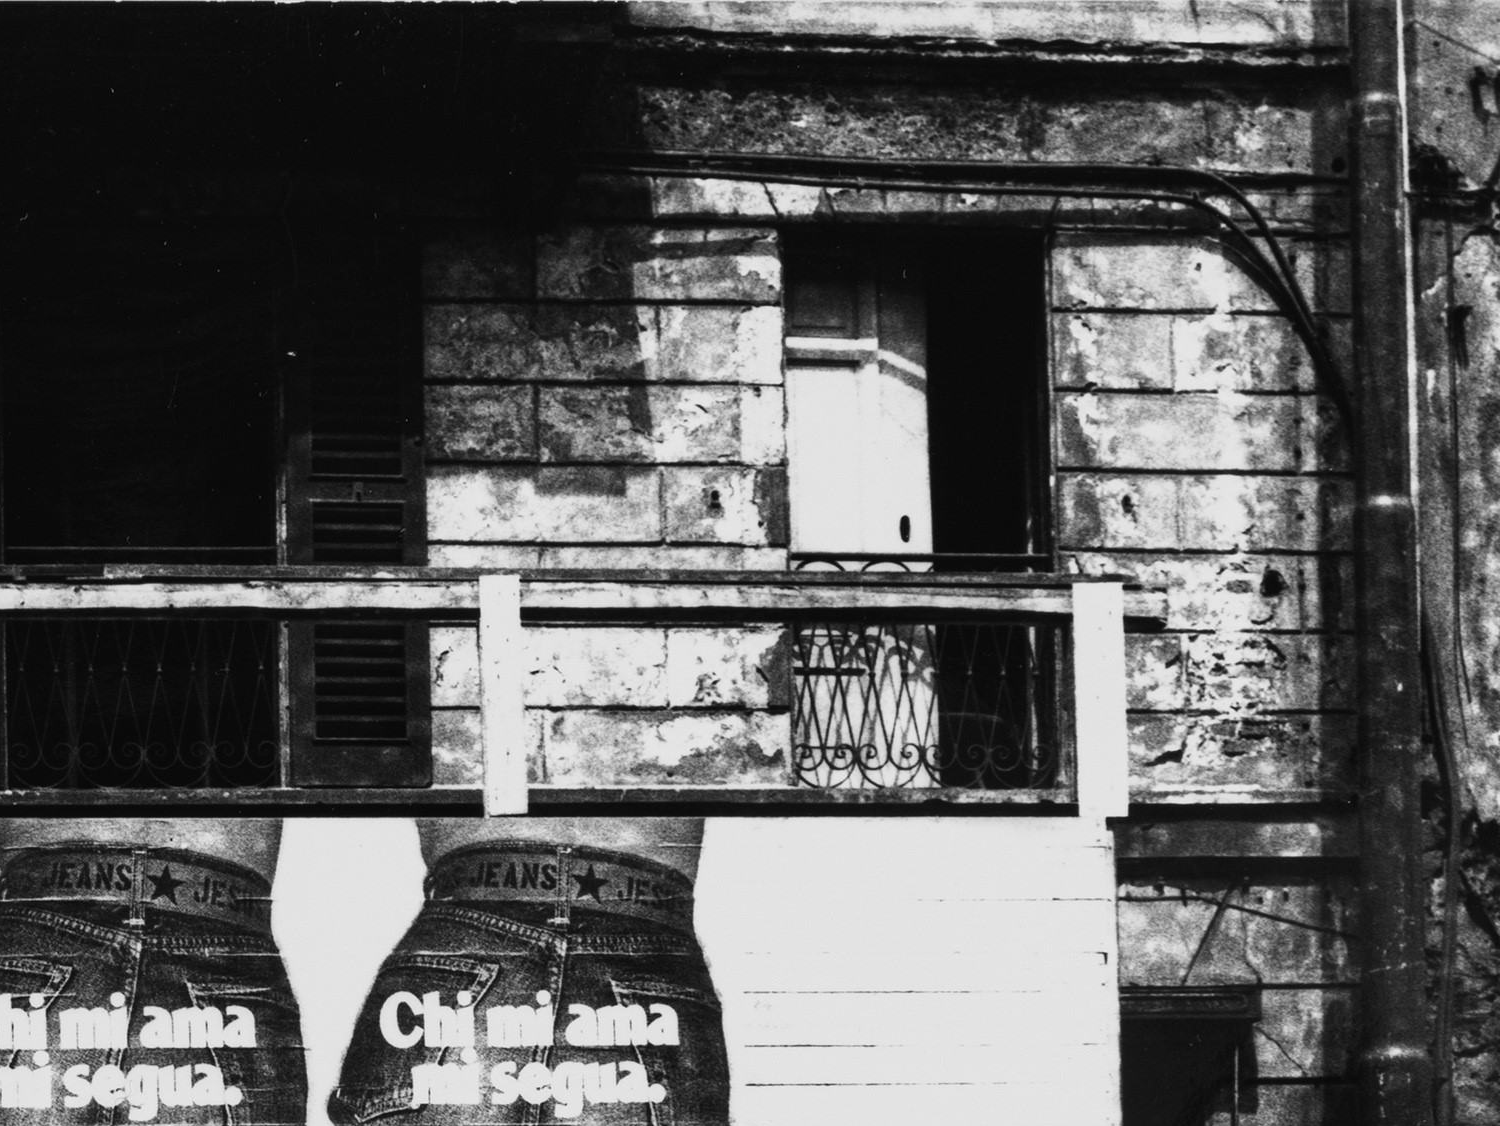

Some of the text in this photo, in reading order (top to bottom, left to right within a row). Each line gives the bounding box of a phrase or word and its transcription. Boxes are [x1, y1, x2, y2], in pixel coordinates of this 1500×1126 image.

[59, 992, 128, 1050] mi
[139, 1005, 257, 1050] ama
[379, 990, 680, 1049] Chi mi ama
[62, 1063, 242, 1121] segua.
[412, 1047, 666, 1118] mi segua.
